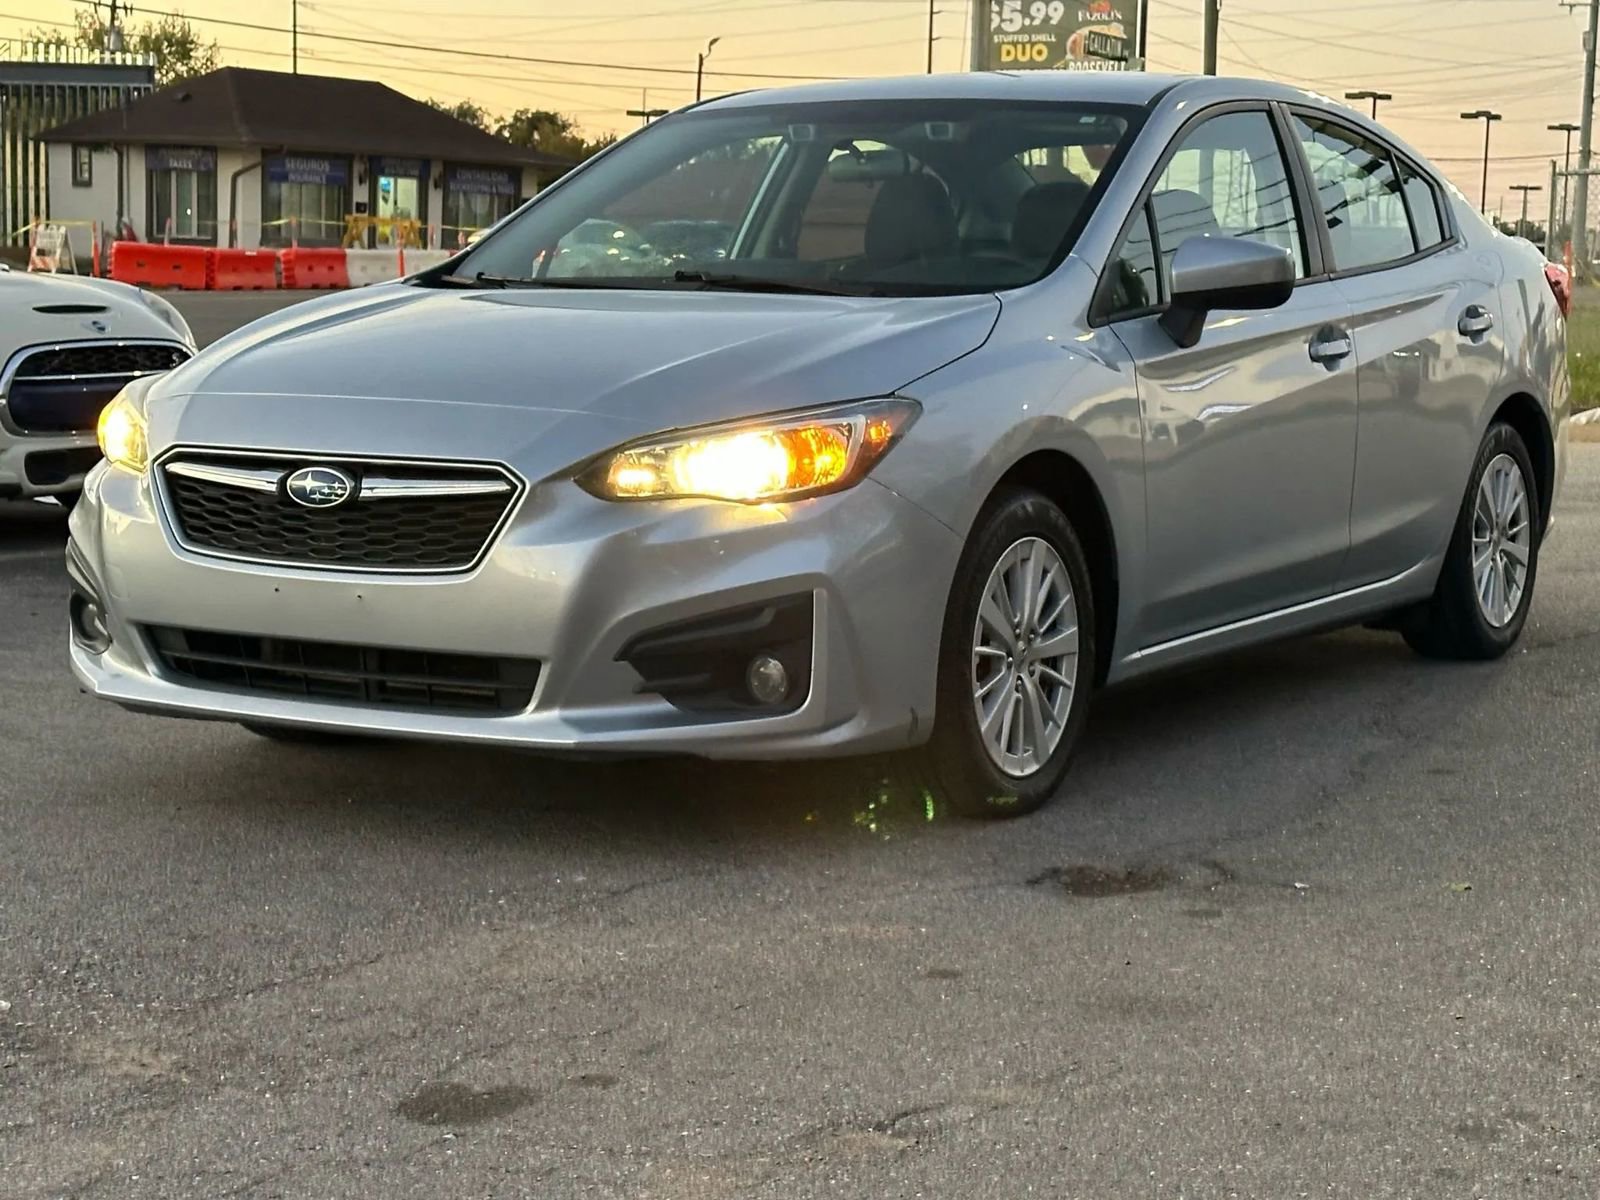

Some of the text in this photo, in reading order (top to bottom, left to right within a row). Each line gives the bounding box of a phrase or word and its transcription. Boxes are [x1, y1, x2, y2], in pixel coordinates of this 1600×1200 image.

[993, 33, 1056, 43] STUFFED SHELL
[1001, 43, 1048, 62] DUO
[285, 157, 330, 172] SEGUROS
